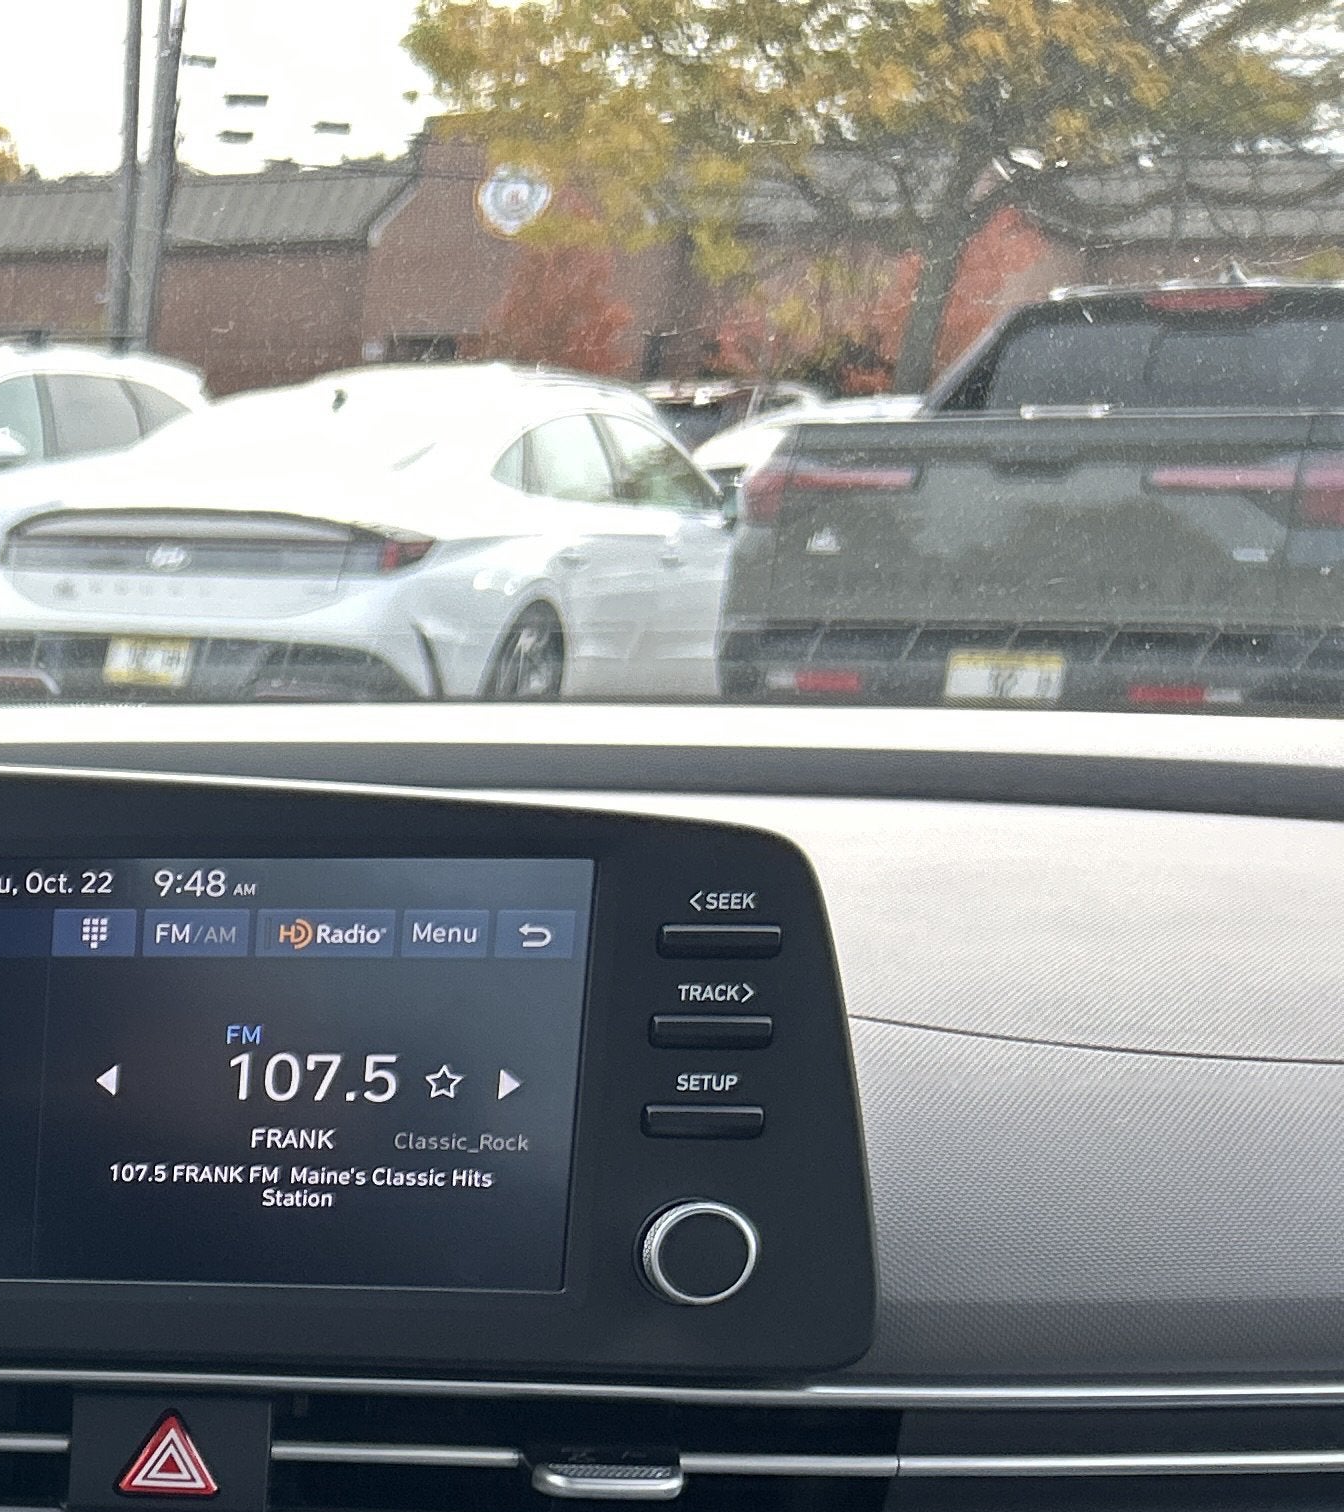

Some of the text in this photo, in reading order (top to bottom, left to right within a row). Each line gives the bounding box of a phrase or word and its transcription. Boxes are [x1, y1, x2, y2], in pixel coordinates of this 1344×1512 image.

[25, 871, 73, 894] Oct.
[80, 871, 114, 894] 22
[153, 869, 227, 898] 9:48
[233, 883, 256, 896] AM
[411, 921, 478, 945] Menu
[225, 1024, 263, 1046] FM
[228, 1051, 399, 1103] 107.5
[675, 1074, 738, 1092] SETUP
[249, 1127, 337, 1150] FRANK
[393, 1131, 530, 1155] Classic_Rock
[109, 1163, 494, 1189] 107.5 FRANK FM Maine's Classic Hits
[261, 1188, 333, 1208] Station
